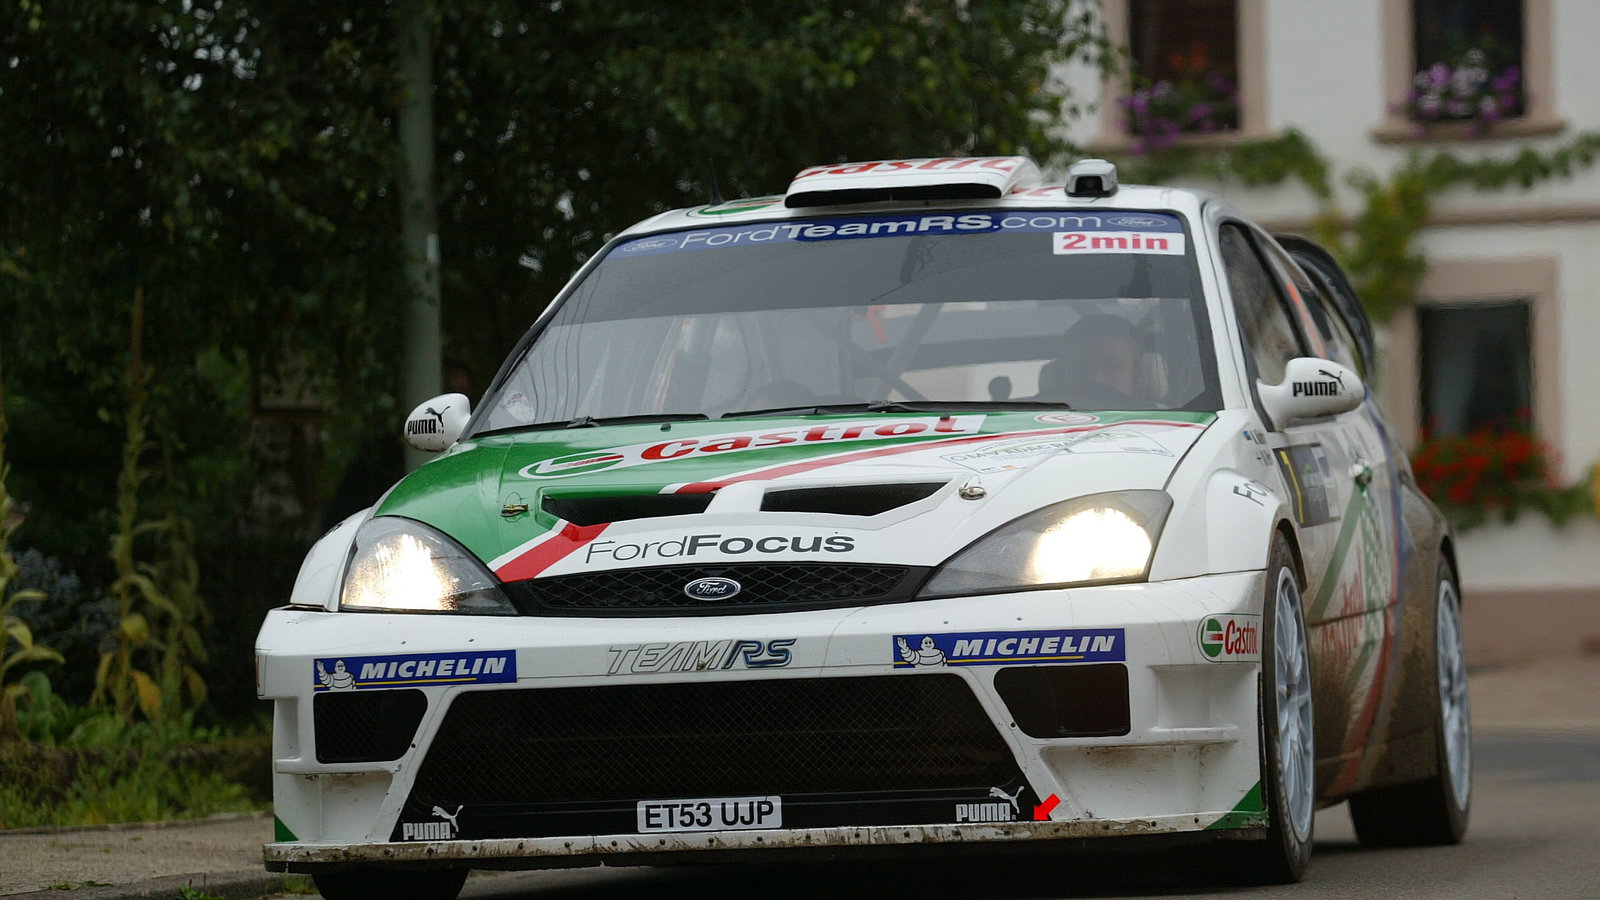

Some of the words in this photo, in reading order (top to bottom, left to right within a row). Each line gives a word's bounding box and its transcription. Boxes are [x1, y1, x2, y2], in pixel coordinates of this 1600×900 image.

[1292, 381, 1338, 398] PUMA
[407, 418, 437, 436] PUMA
[640, 415, 967, 461] Castrol
[586, 532, 855, 564] FordFocus
[951, 634, 1116, 657] MICHELIN
[1224, 619, 1259, 655] Castrol
[359, 656, 508, 680] MICHELIN
[644, 802, 712, 829] ET53
[720, 799, 775, 826] UJP
[956, 803, 1011, 823] PUMA
[402, 820, 452, 841] PUMA
